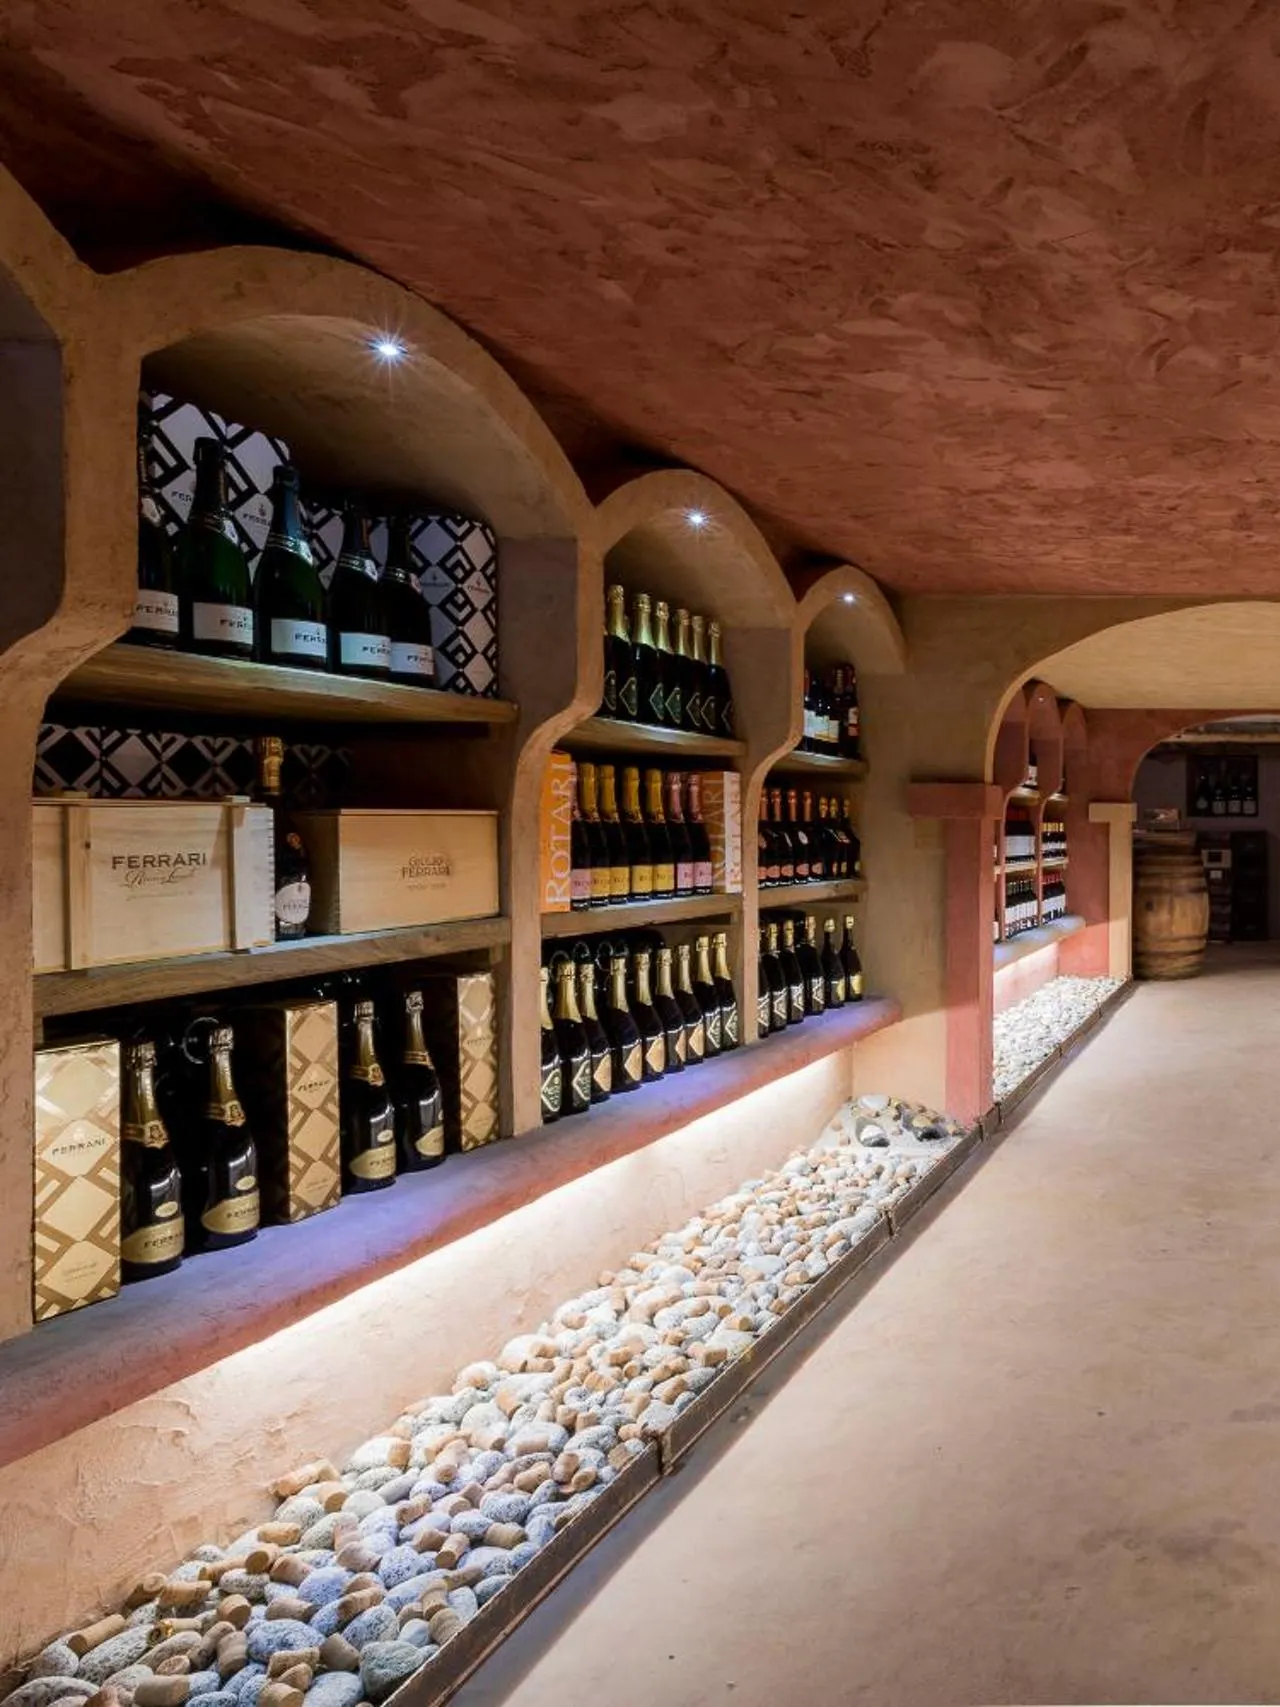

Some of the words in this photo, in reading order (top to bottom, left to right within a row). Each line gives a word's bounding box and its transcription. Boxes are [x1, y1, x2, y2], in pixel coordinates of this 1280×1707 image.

[545, 764, 571, 903] ROTARI
[111, 852, 206, 871] FERRARI
[52, 1138, 106, 1156] FERRARI
